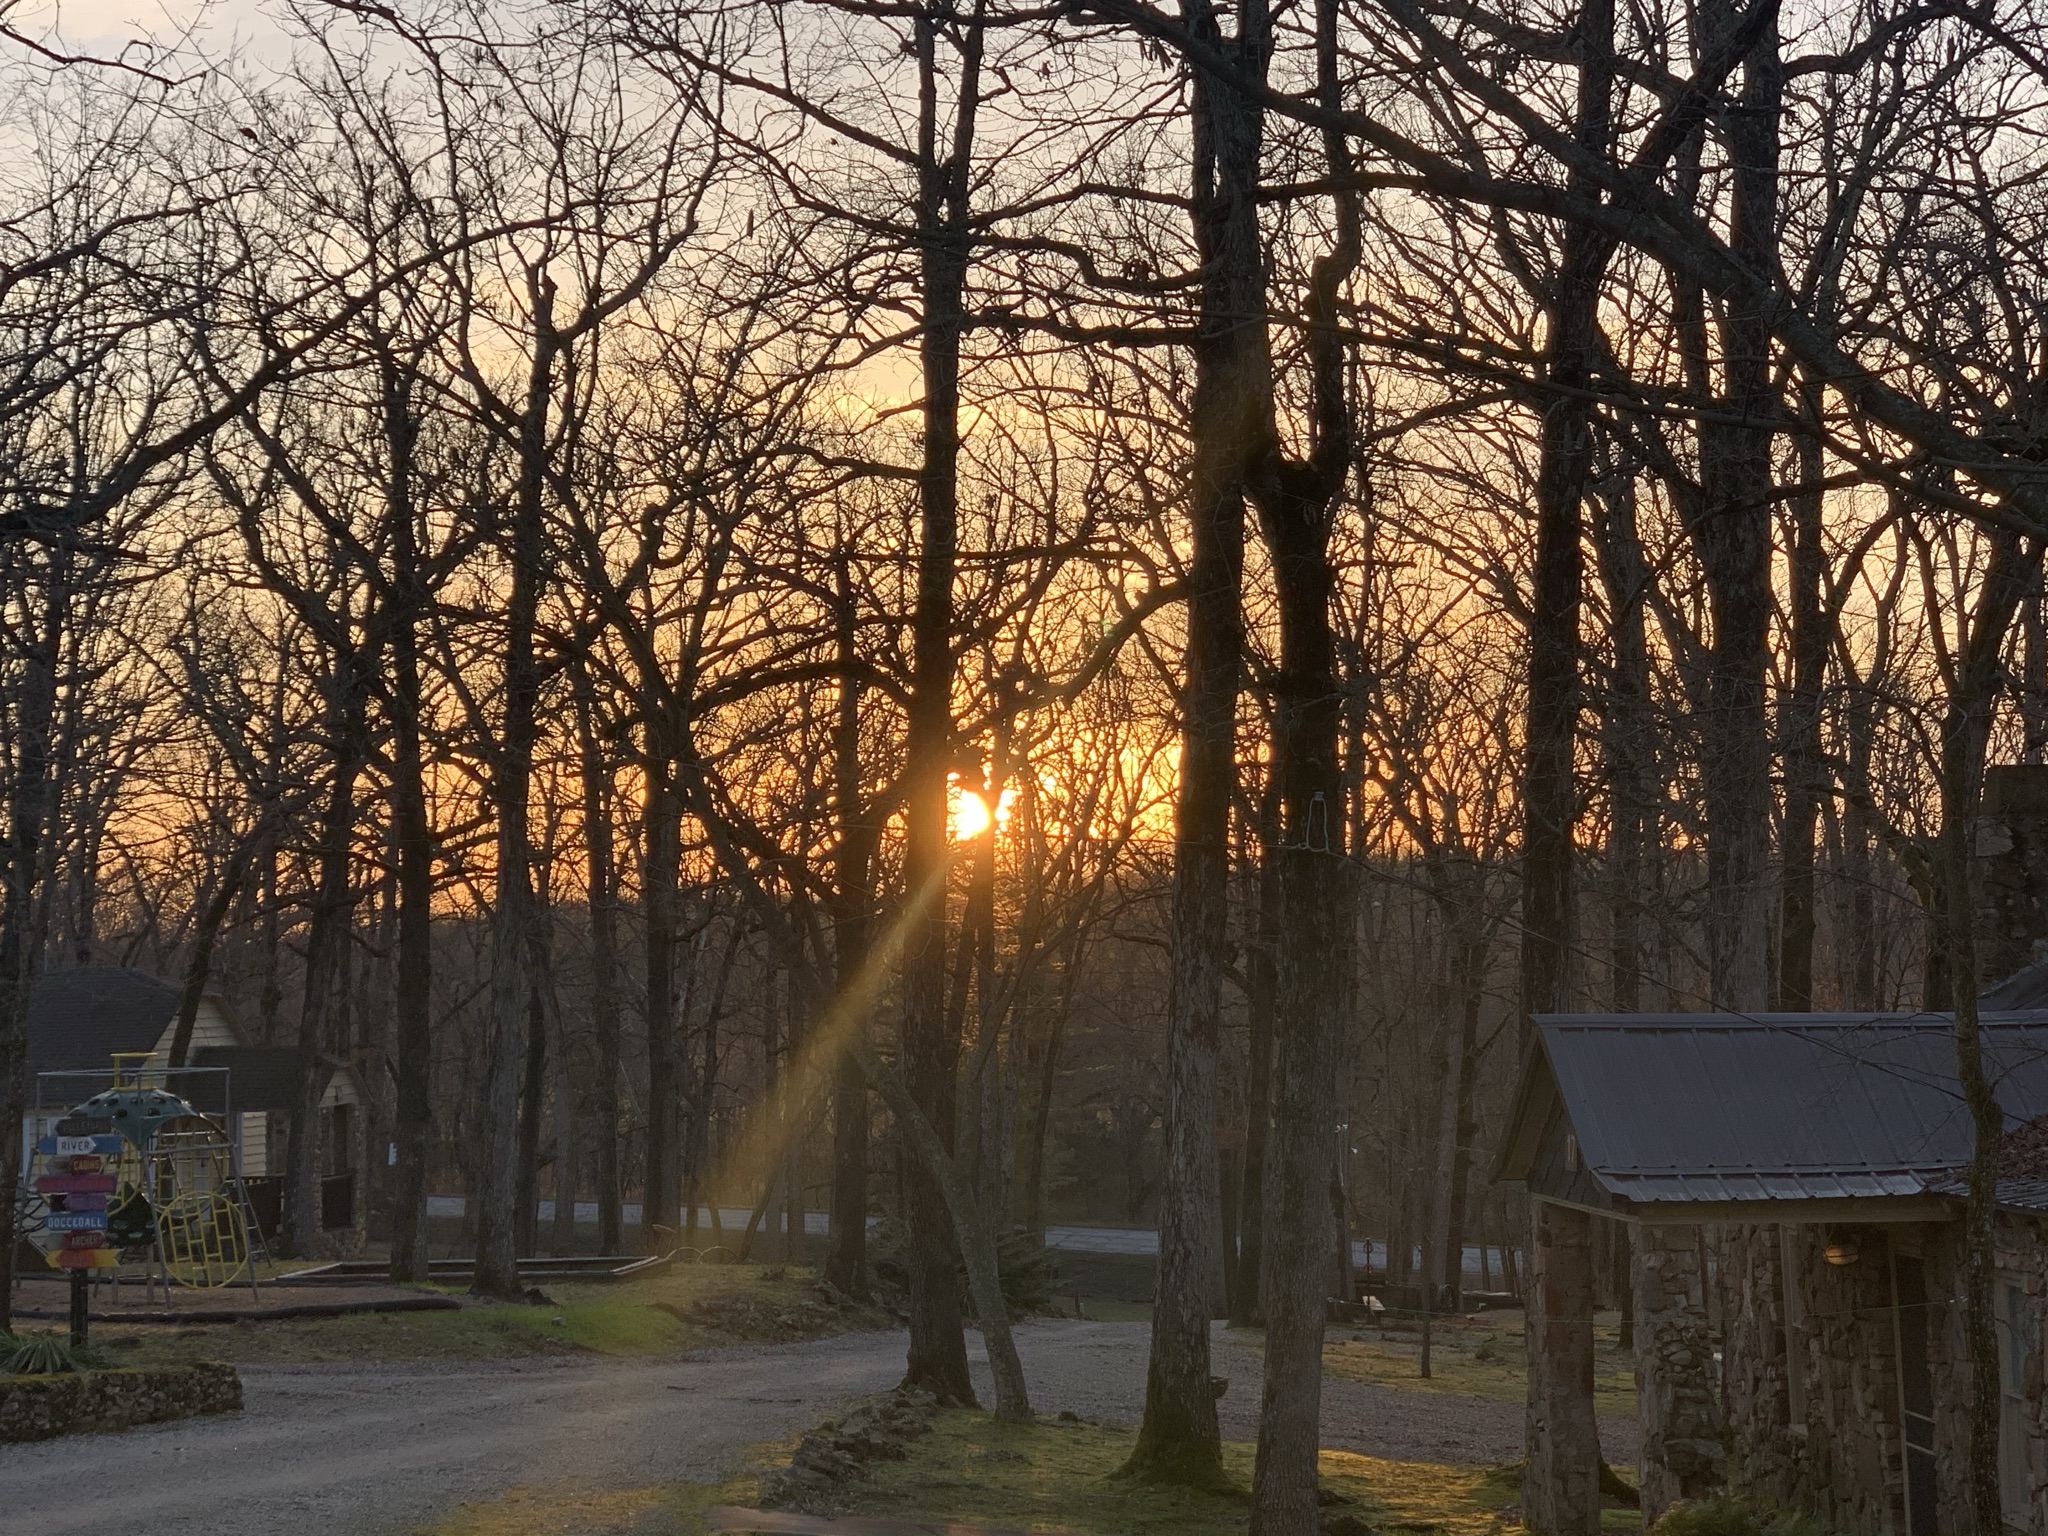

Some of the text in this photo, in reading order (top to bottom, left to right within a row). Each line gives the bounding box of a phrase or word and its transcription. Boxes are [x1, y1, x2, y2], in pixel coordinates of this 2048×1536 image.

[61, 1141, 90, 1151] RIVER
[73, 1160, 99, 1171] CABINS
[71, 1235, 102, 1246] ARCHERY
